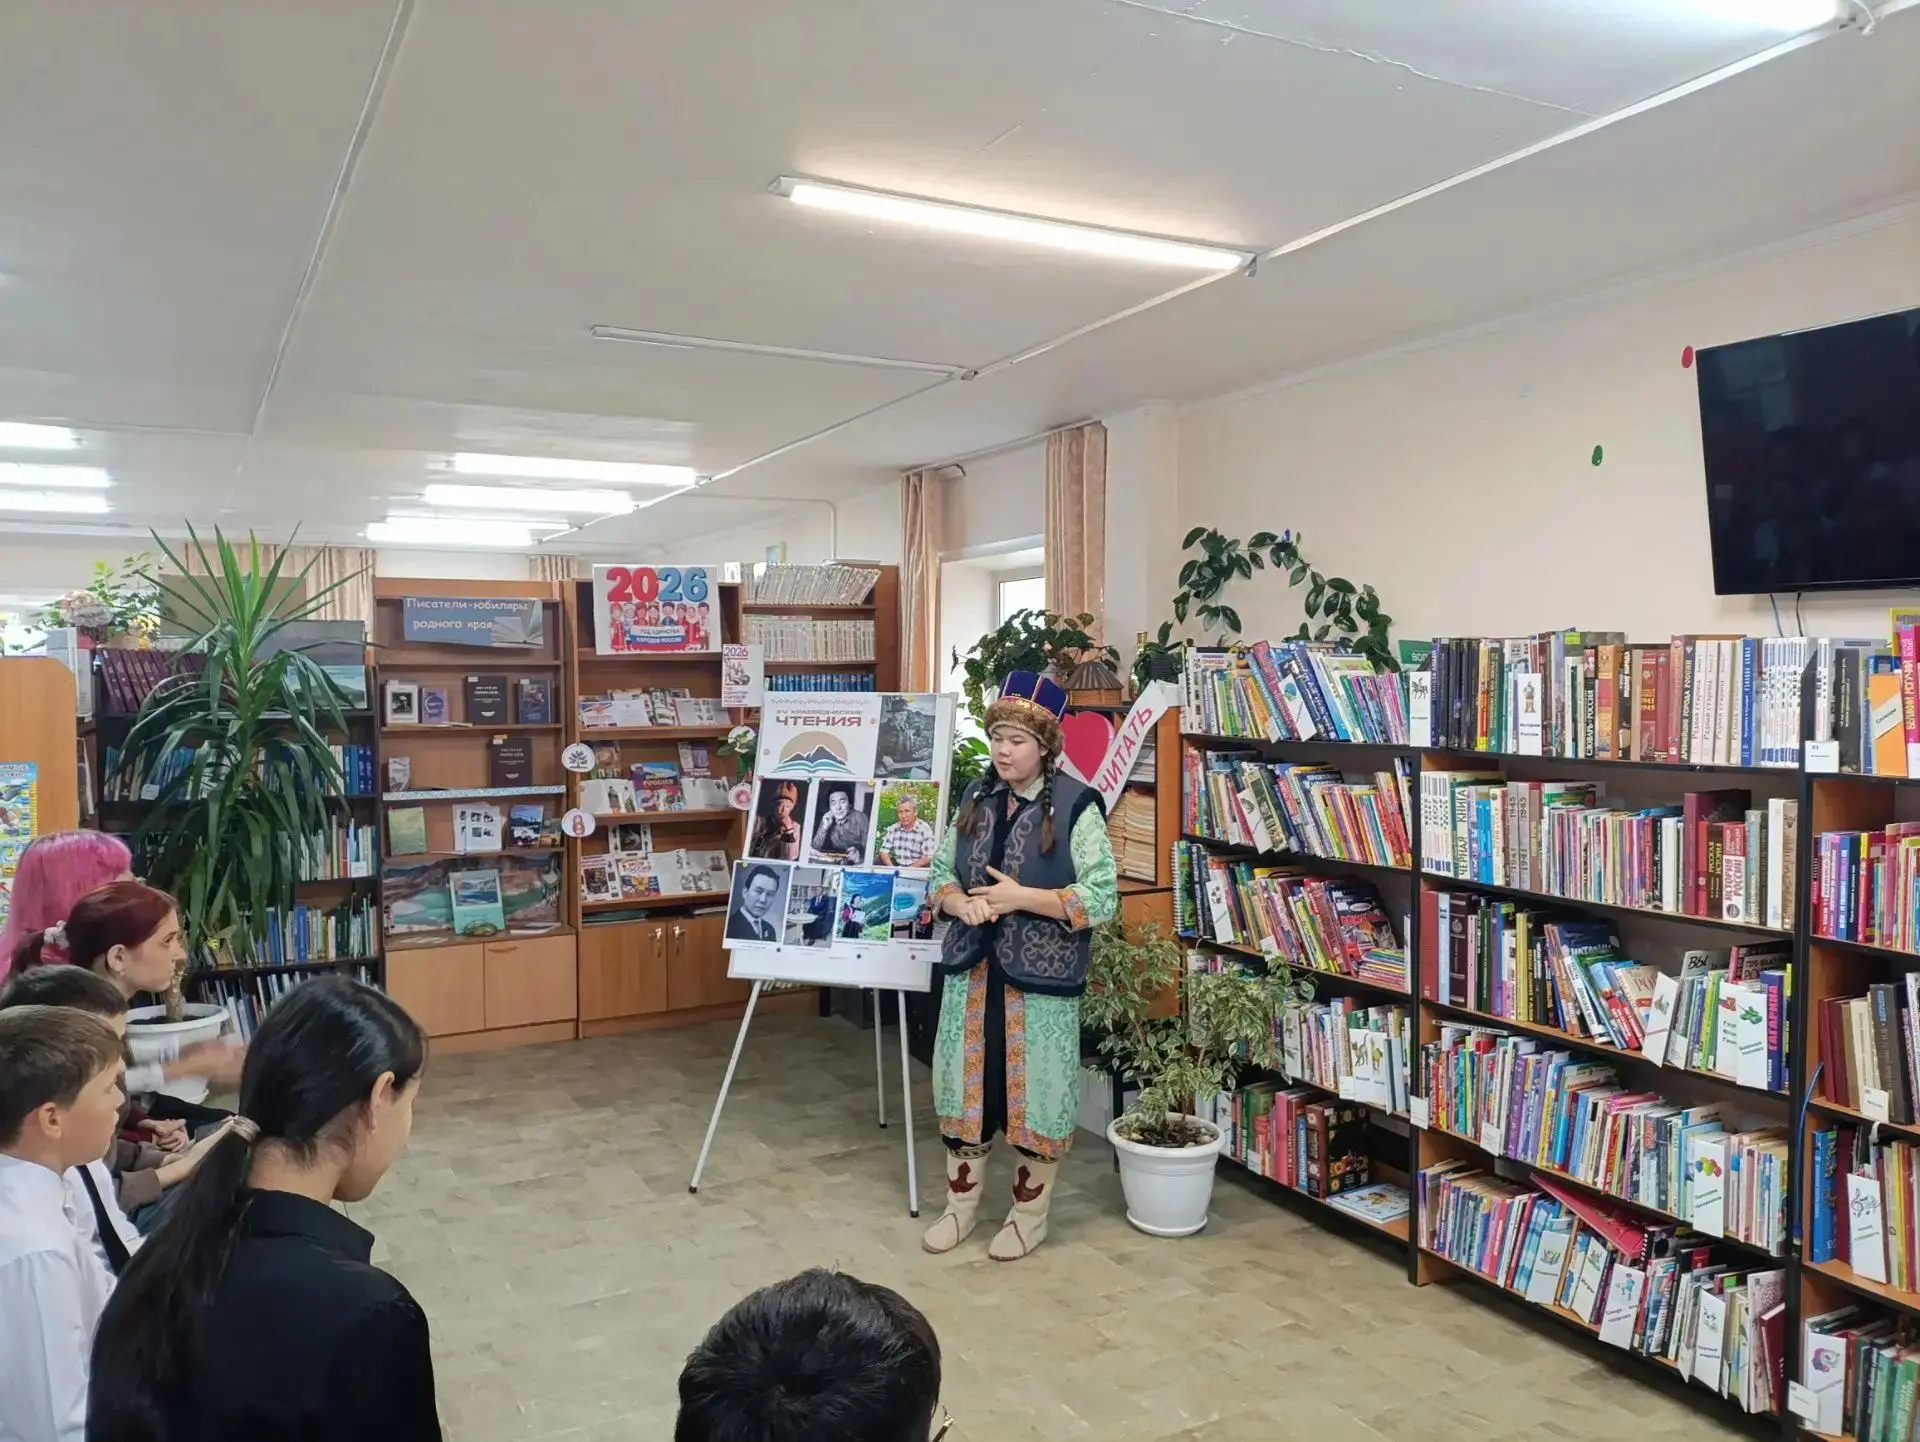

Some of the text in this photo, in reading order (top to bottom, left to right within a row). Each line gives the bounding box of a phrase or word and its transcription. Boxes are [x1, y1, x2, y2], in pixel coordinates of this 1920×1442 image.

[607, 567, 708, 602] 2026
[406, 597, 528, 612] Писатели-юбиляры
[413, 620, 493, 631] родного края
[724, 646, 748, 657] 2026
[1684, 659, 1692, 688] РОССИИ
[1682, 690, 1690, 717] ГОРОДА
[775, 715, 862, 727] ЧТЕНИЯ
[1097, 706, 1153, 794] ЧИТАТЬ
[1586, 723, 1594, 756] СЛОВАРЬ
[1509, 796, 1517, 819] 1945
[1455, 789, 1468, 876] ЧЕРНАЯ КНИГА
[1519, 796, 1528, 872] 1941 1945
[1724, 858, 1733, 901] ИСТОРИЯ
[1733, 858, 1743, 897] РОССИИ
[1767, 985, 1779, 1051] ГАГАРИНА
